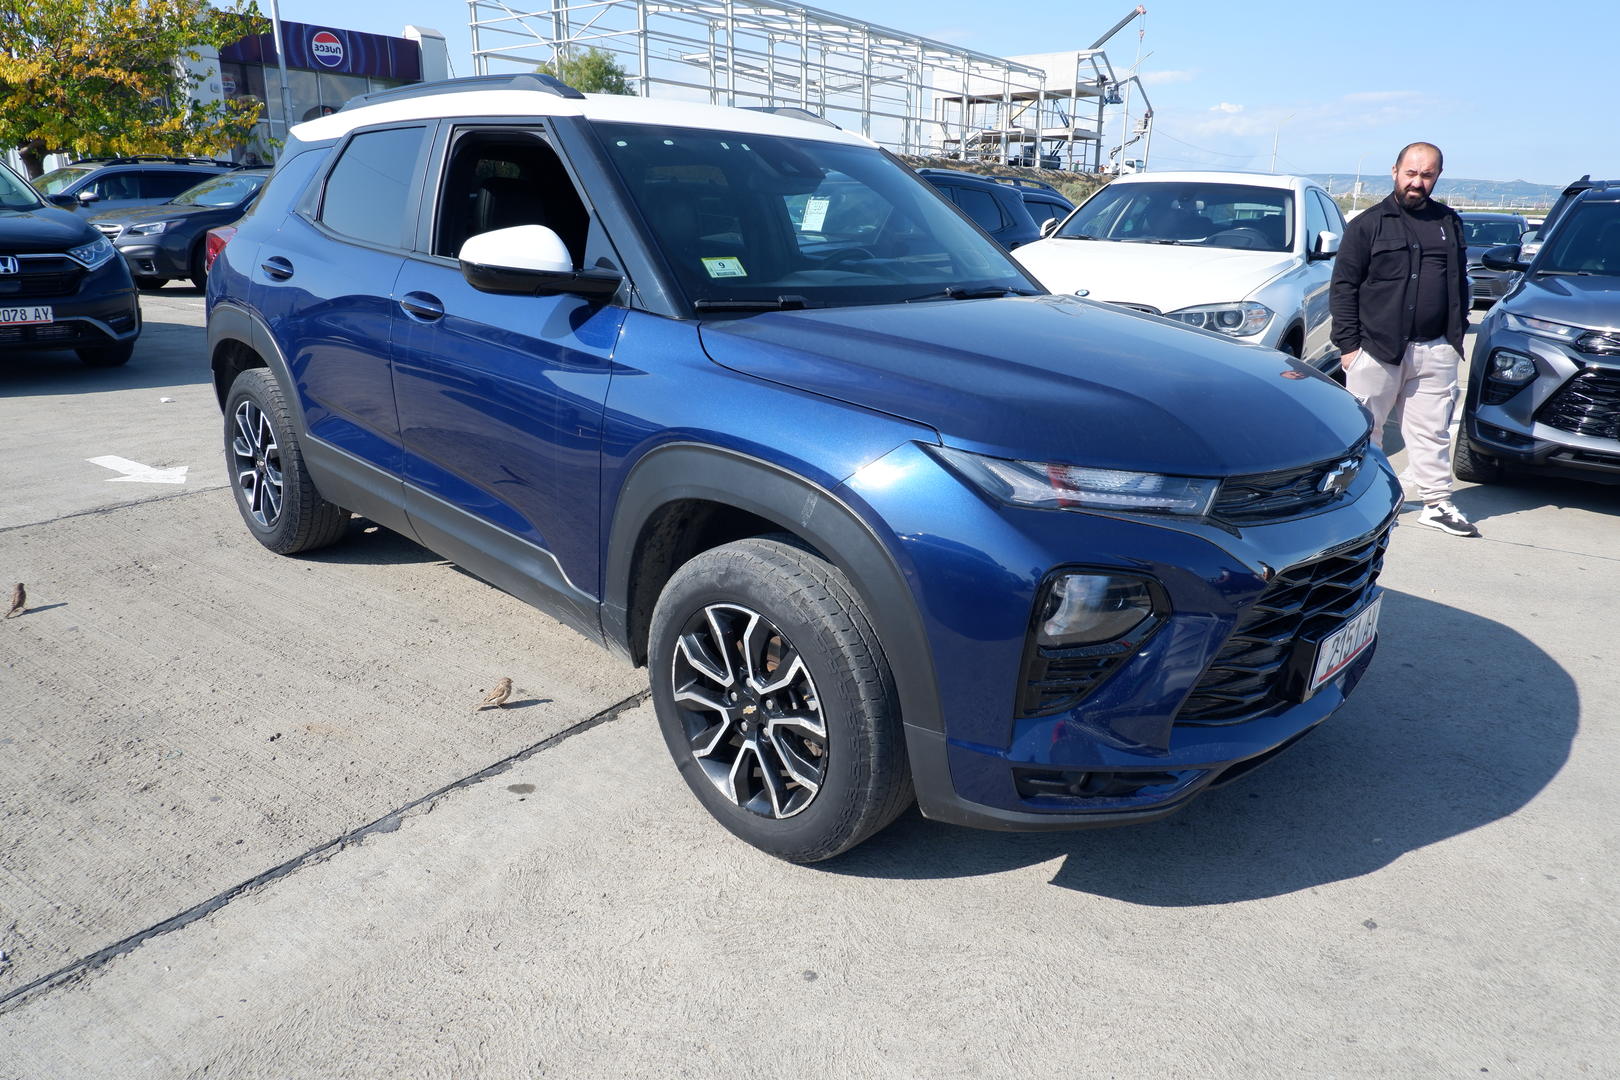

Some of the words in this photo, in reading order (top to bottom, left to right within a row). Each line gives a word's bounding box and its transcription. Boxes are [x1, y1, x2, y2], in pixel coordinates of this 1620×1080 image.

[0, 309, 27, 322] 078
[34, 308, 49, 320] AY
[1326, 616, 1362, 672] 2151
